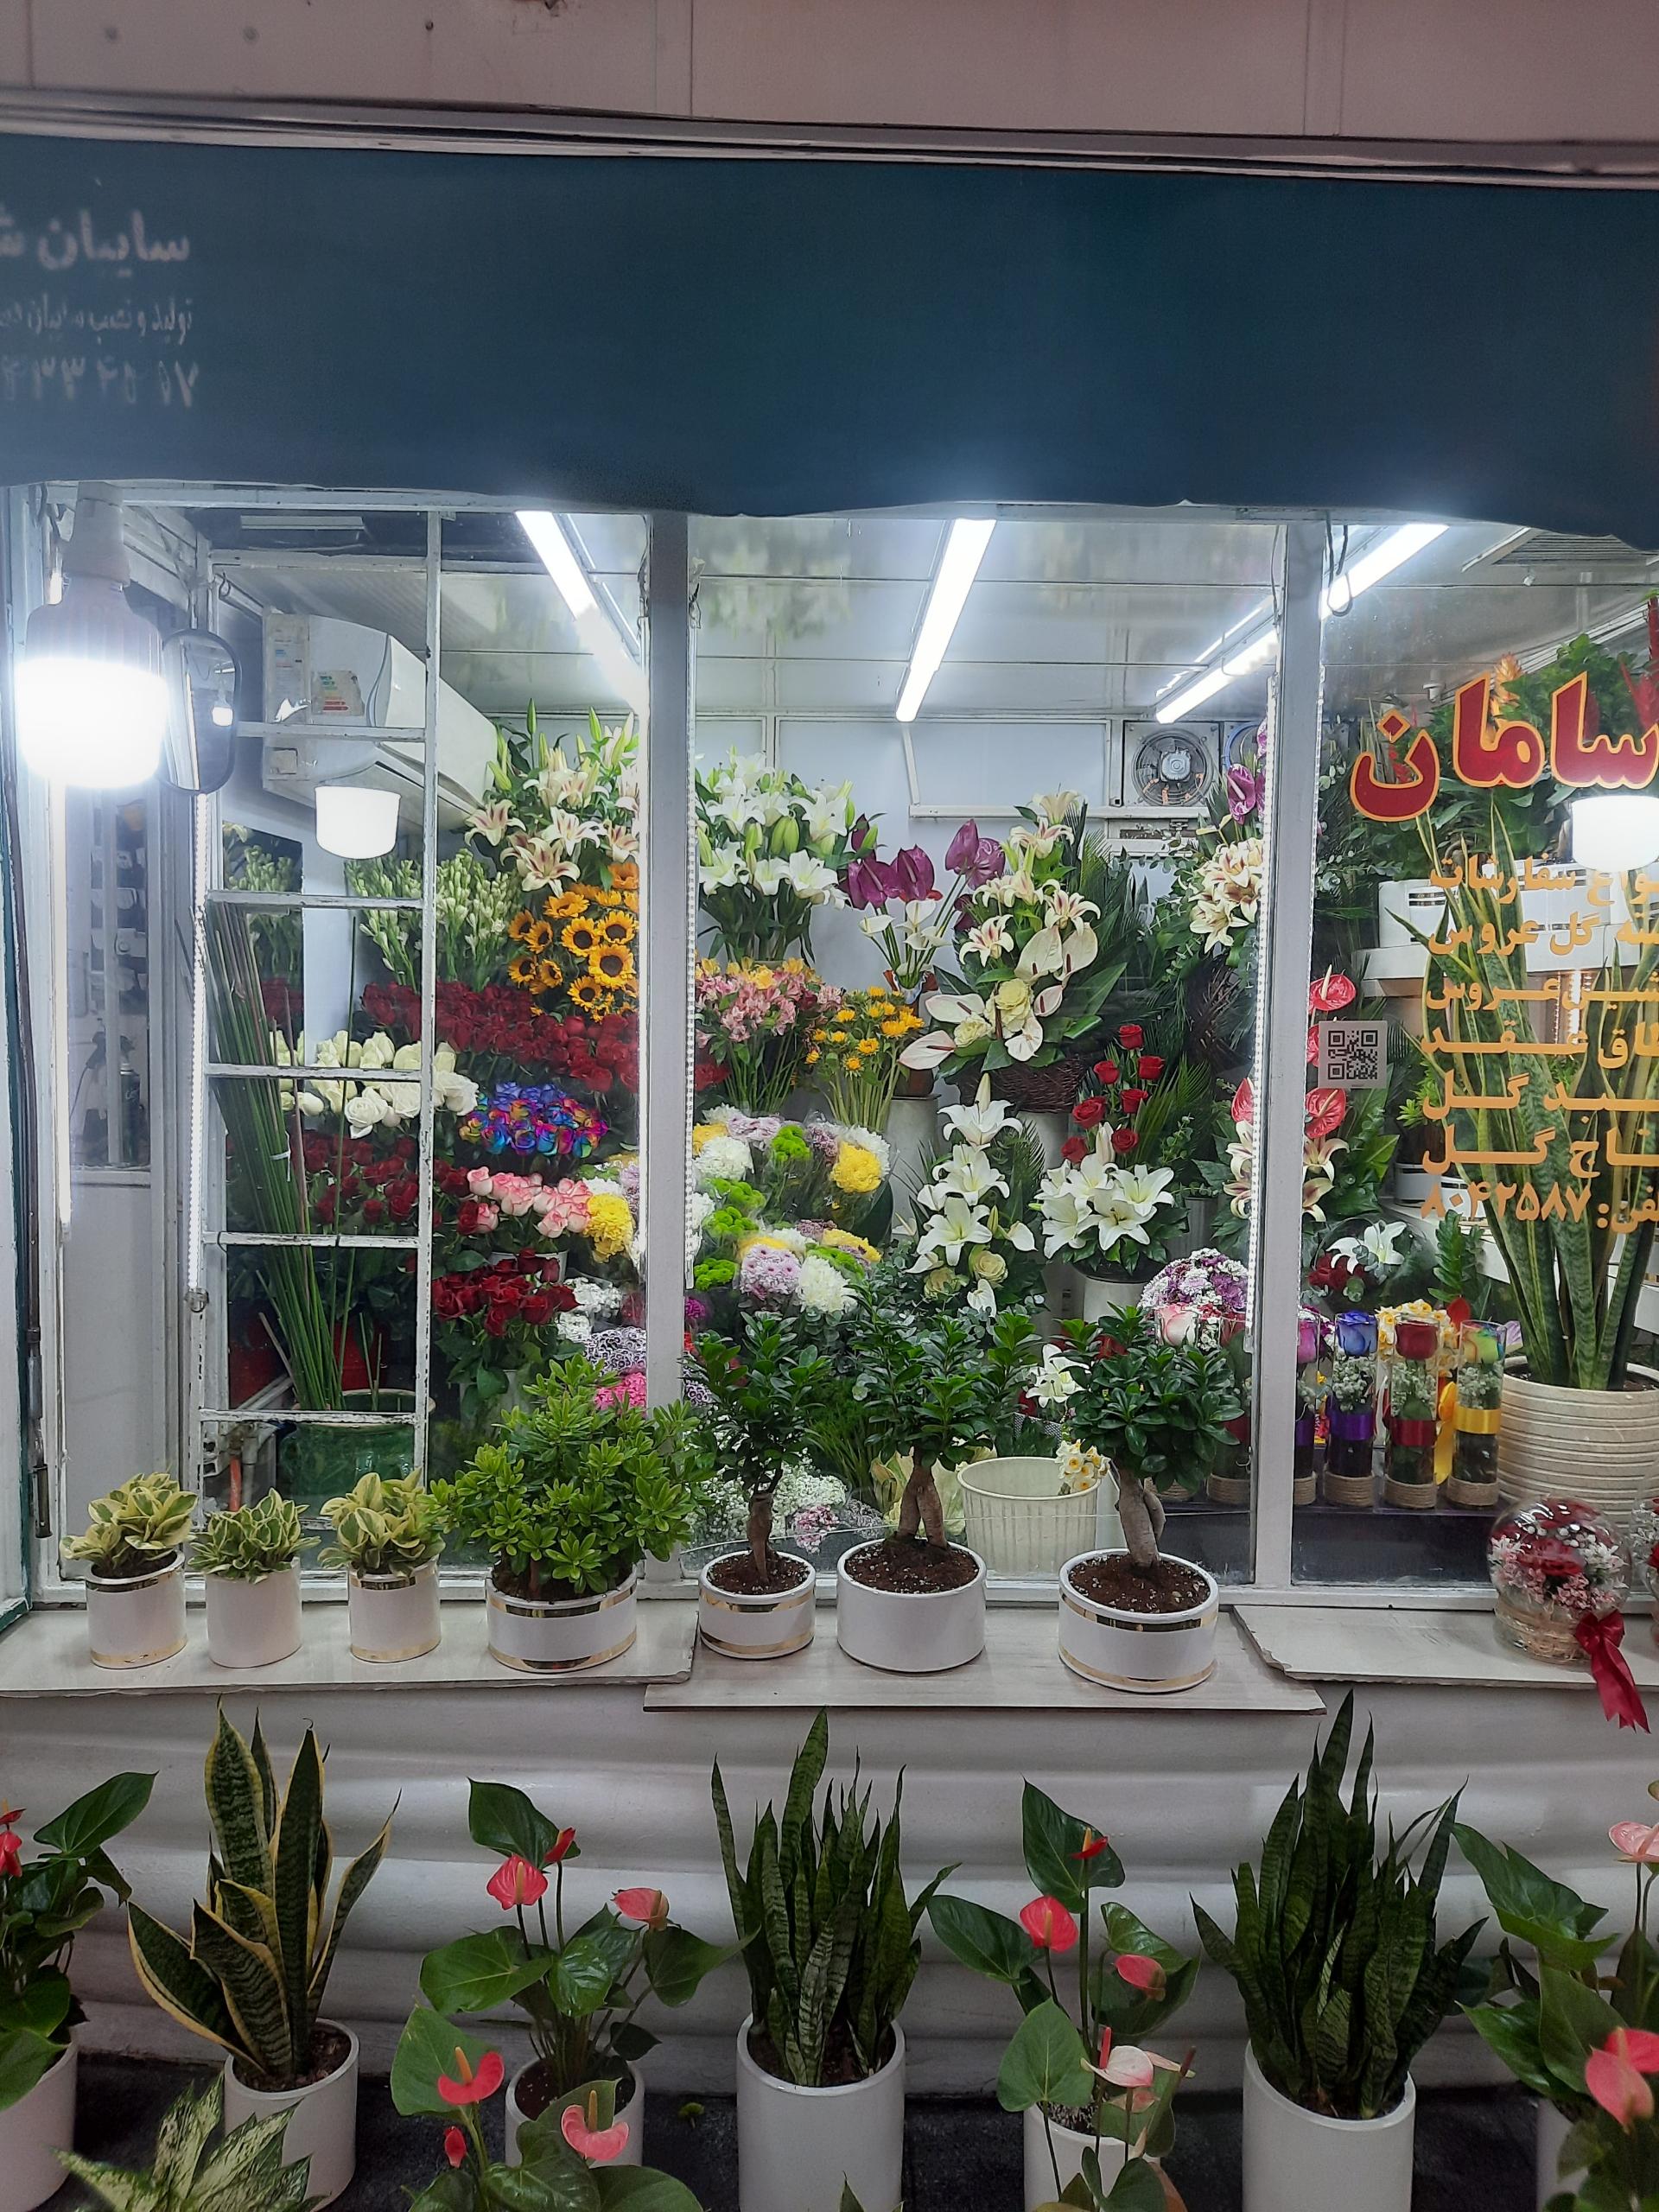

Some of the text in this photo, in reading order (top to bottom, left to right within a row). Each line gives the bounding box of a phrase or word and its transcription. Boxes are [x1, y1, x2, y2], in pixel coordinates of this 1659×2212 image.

[1350, 671, 1659, 822] سامان
[1430, 852, 1576, 905] سفارشات
[1428, 919, 1539, 956] عروس
[1550, 911, 1600, 956] گل
[1427, 977, 1560, 1011] عروس
[1421, 1020, 1589, 1054] عقد
[1422, 1068, 1659, 1124] بد گل
[1421, 1123, 1555, 1175] گل
[1421, 1181, 1592, 1223] ۸۰۴۲۵۸۷
